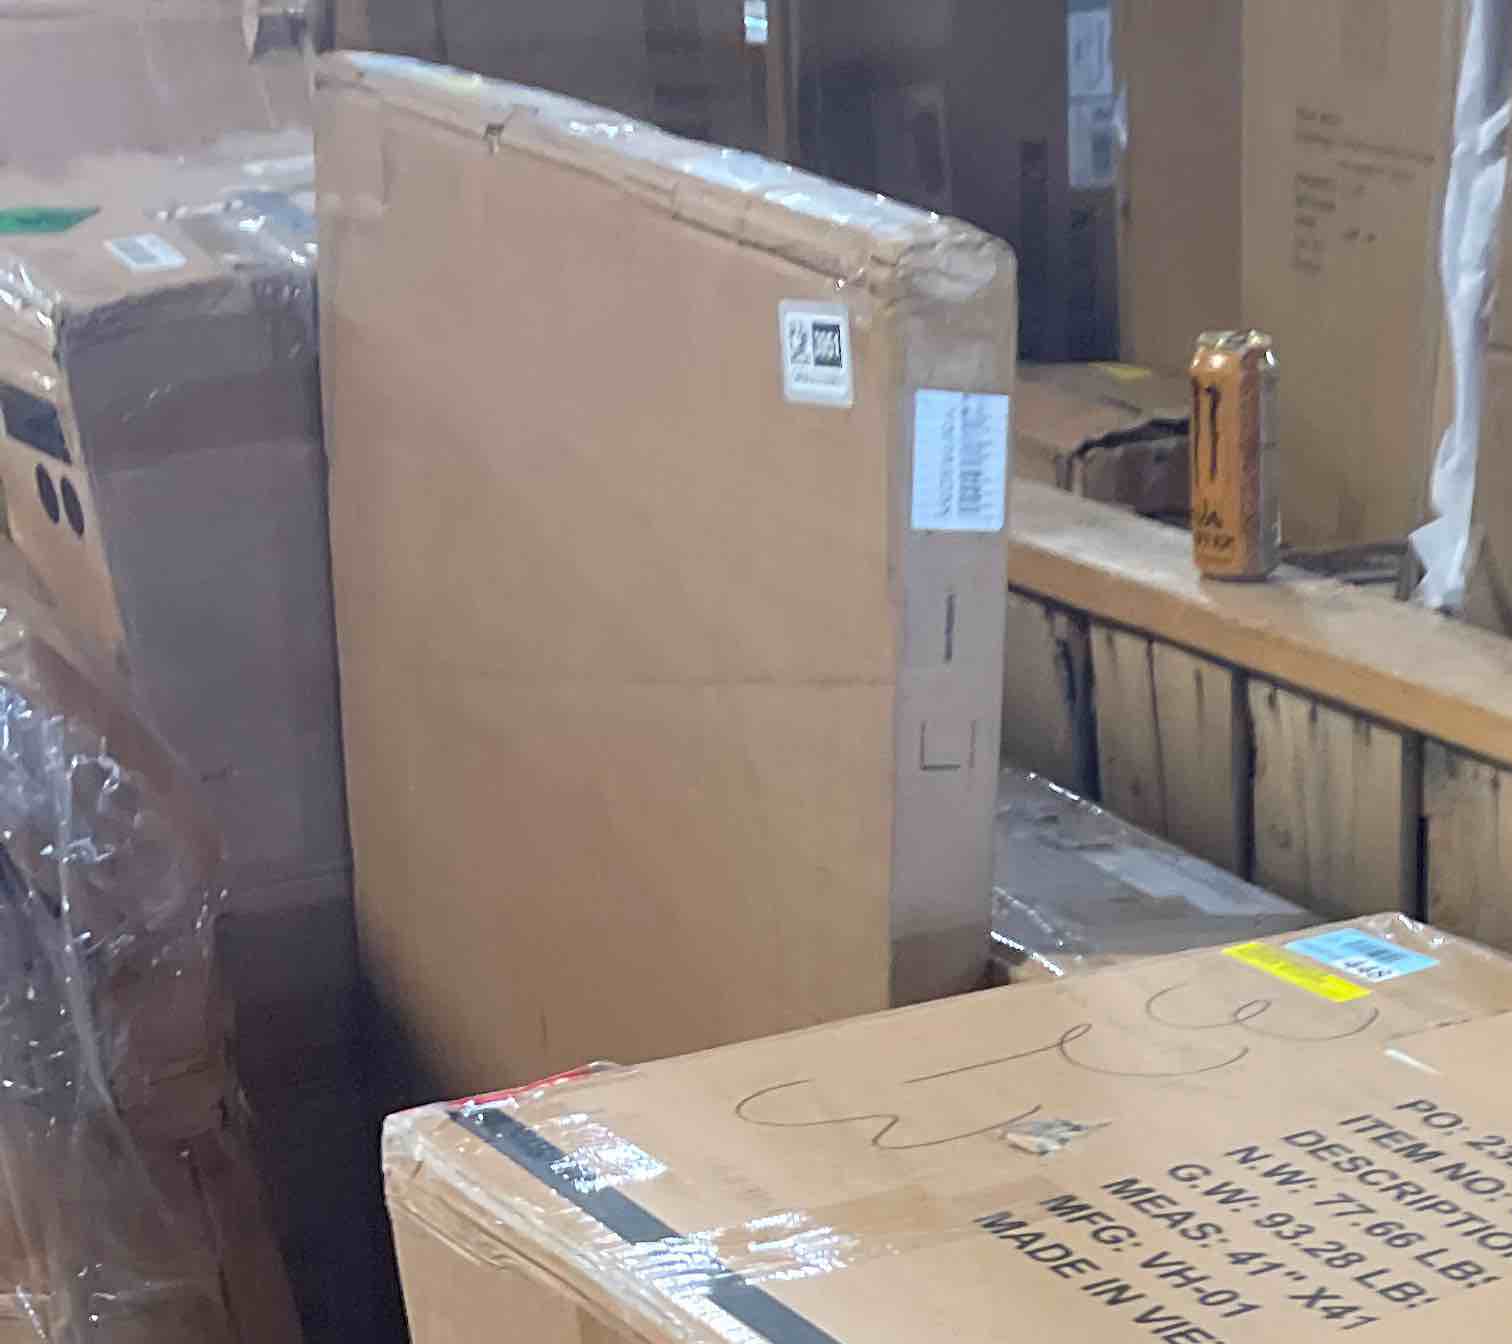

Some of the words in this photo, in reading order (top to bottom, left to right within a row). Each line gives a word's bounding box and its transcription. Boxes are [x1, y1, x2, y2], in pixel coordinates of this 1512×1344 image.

[1337, 1113, 1445, 1164] ITEM
[1395, 1099, 1471, 1136] PO:
[1100, 1177, 1230, 1248] MEAS:
[1168, 1163, 1260, 1213] G.W:
[1252, 1211, 1367, 1269] 93.28
[1223, 1145, 1318, 1194] N.W:
[1313, 1192, 1427, 1249] 77.66
[972, 1210, 1104, 1280] MADE
[1080, 1277, 1149, 1307] IN
[1039, 1193, 1144, 1252] MFG:
[1140, 1250, 1262, 1319] VH-01
